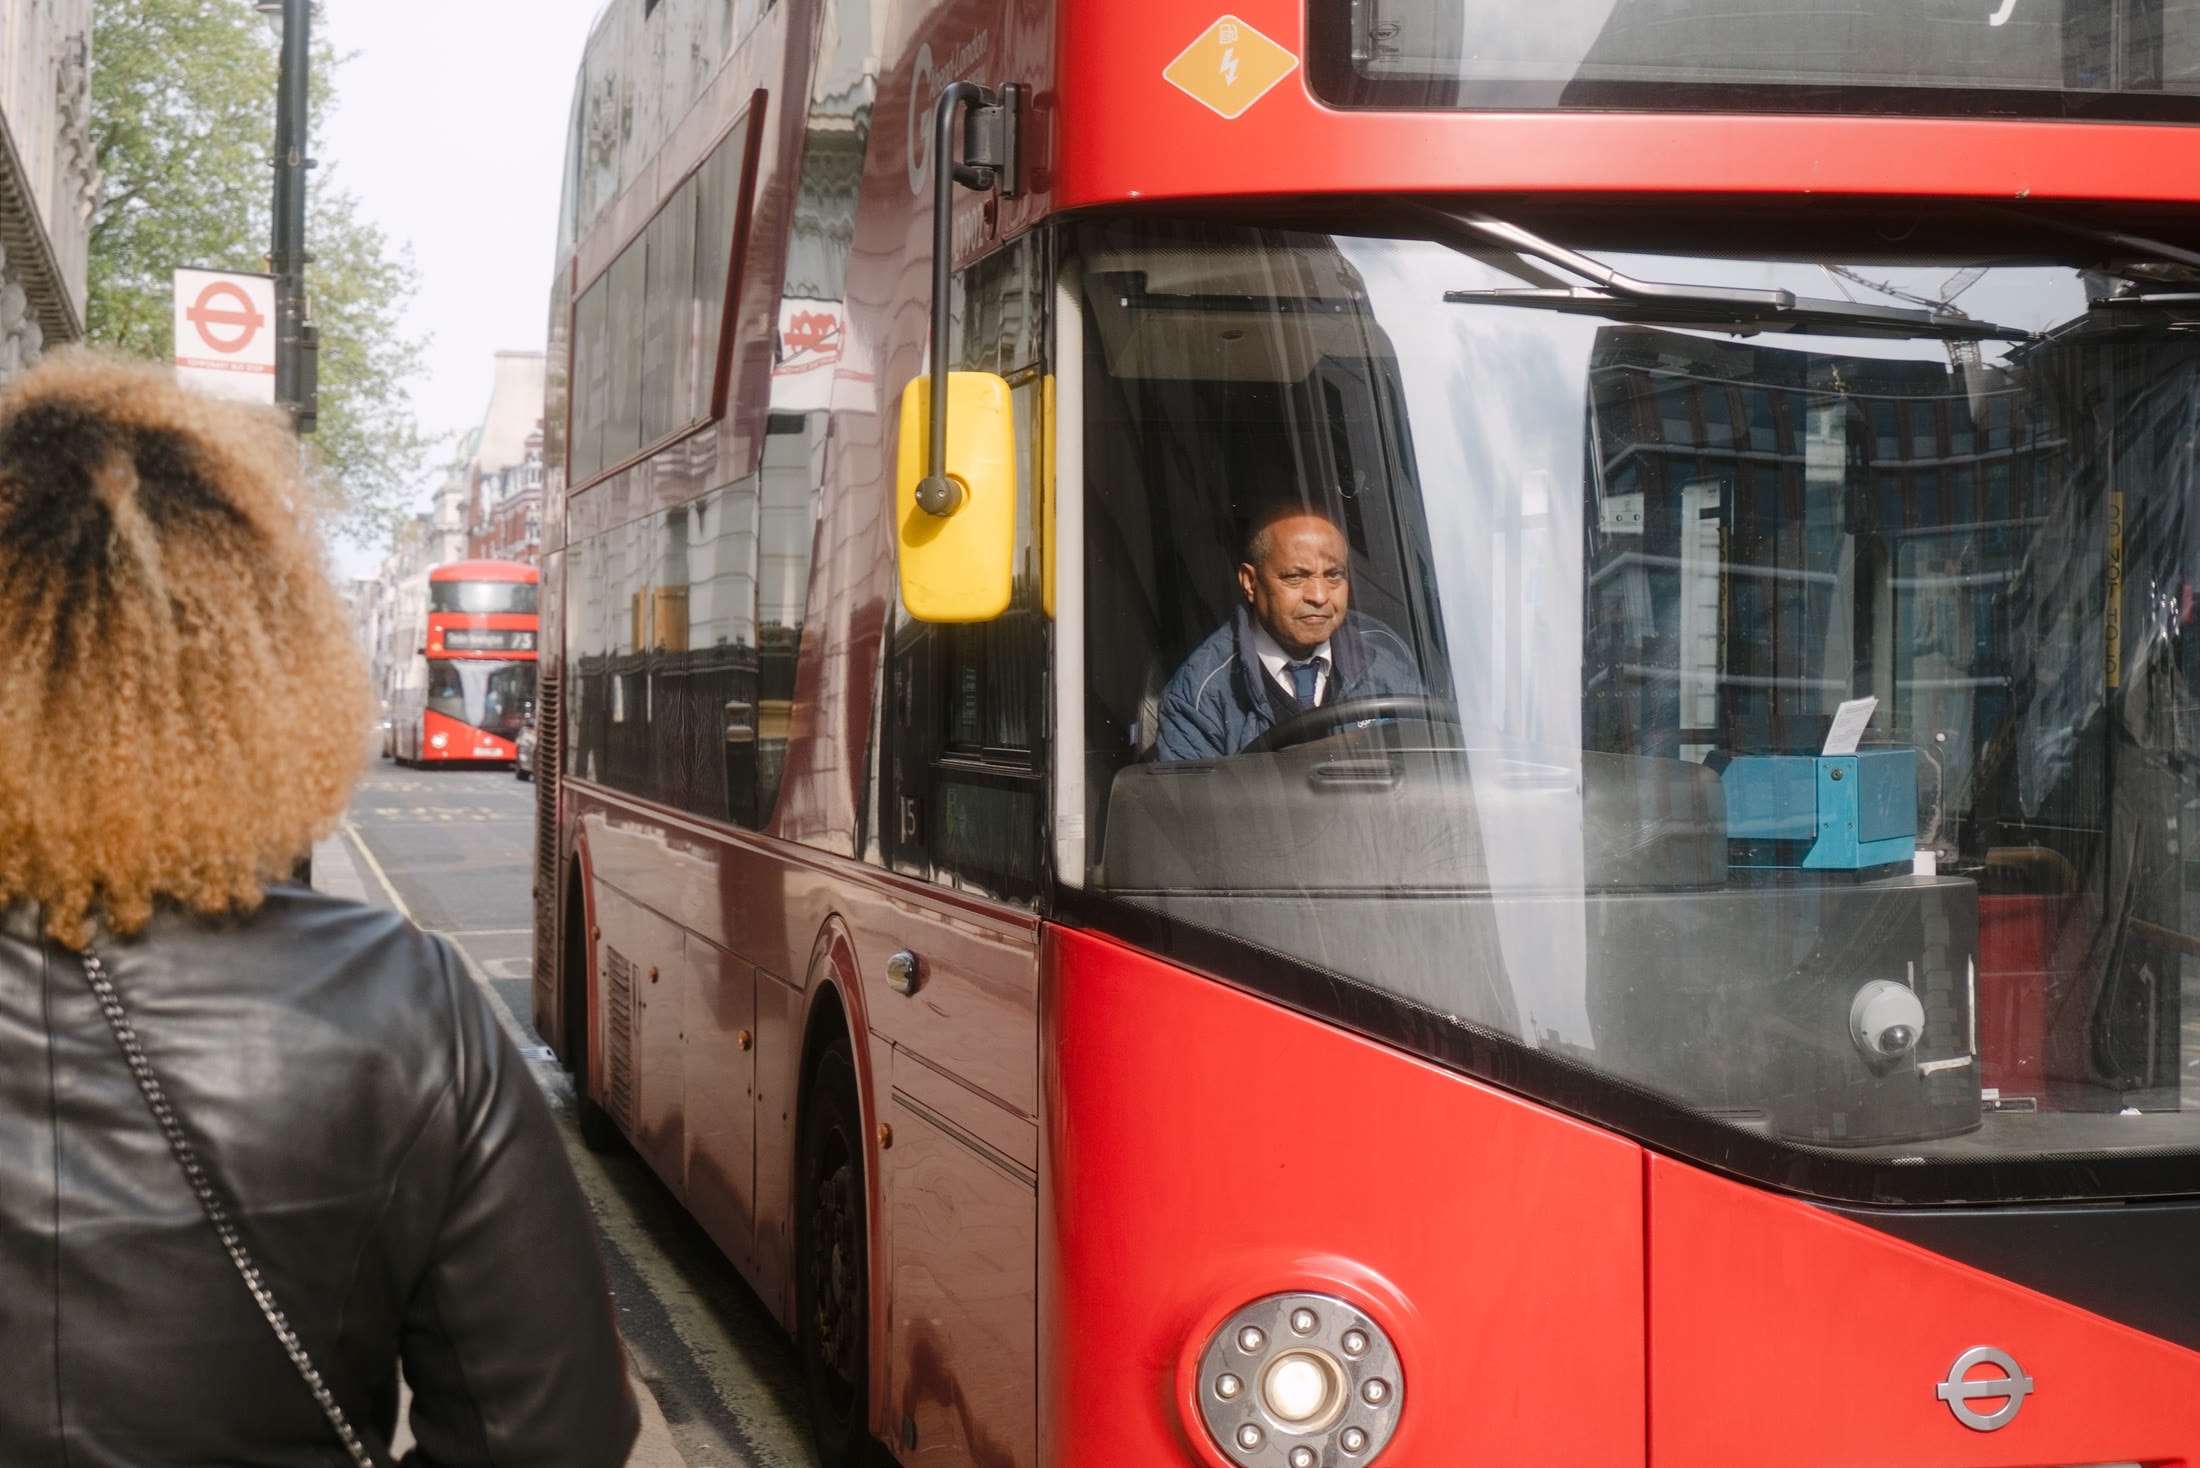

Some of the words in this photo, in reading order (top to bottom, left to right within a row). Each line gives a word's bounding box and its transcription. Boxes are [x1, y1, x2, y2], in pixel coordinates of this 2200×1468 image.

[955, 28, 988, 79] London
[231, 362, 245, 371] BUS
[246, 363, 264, 373] STOP
[510, 632, 533, 650] 73
